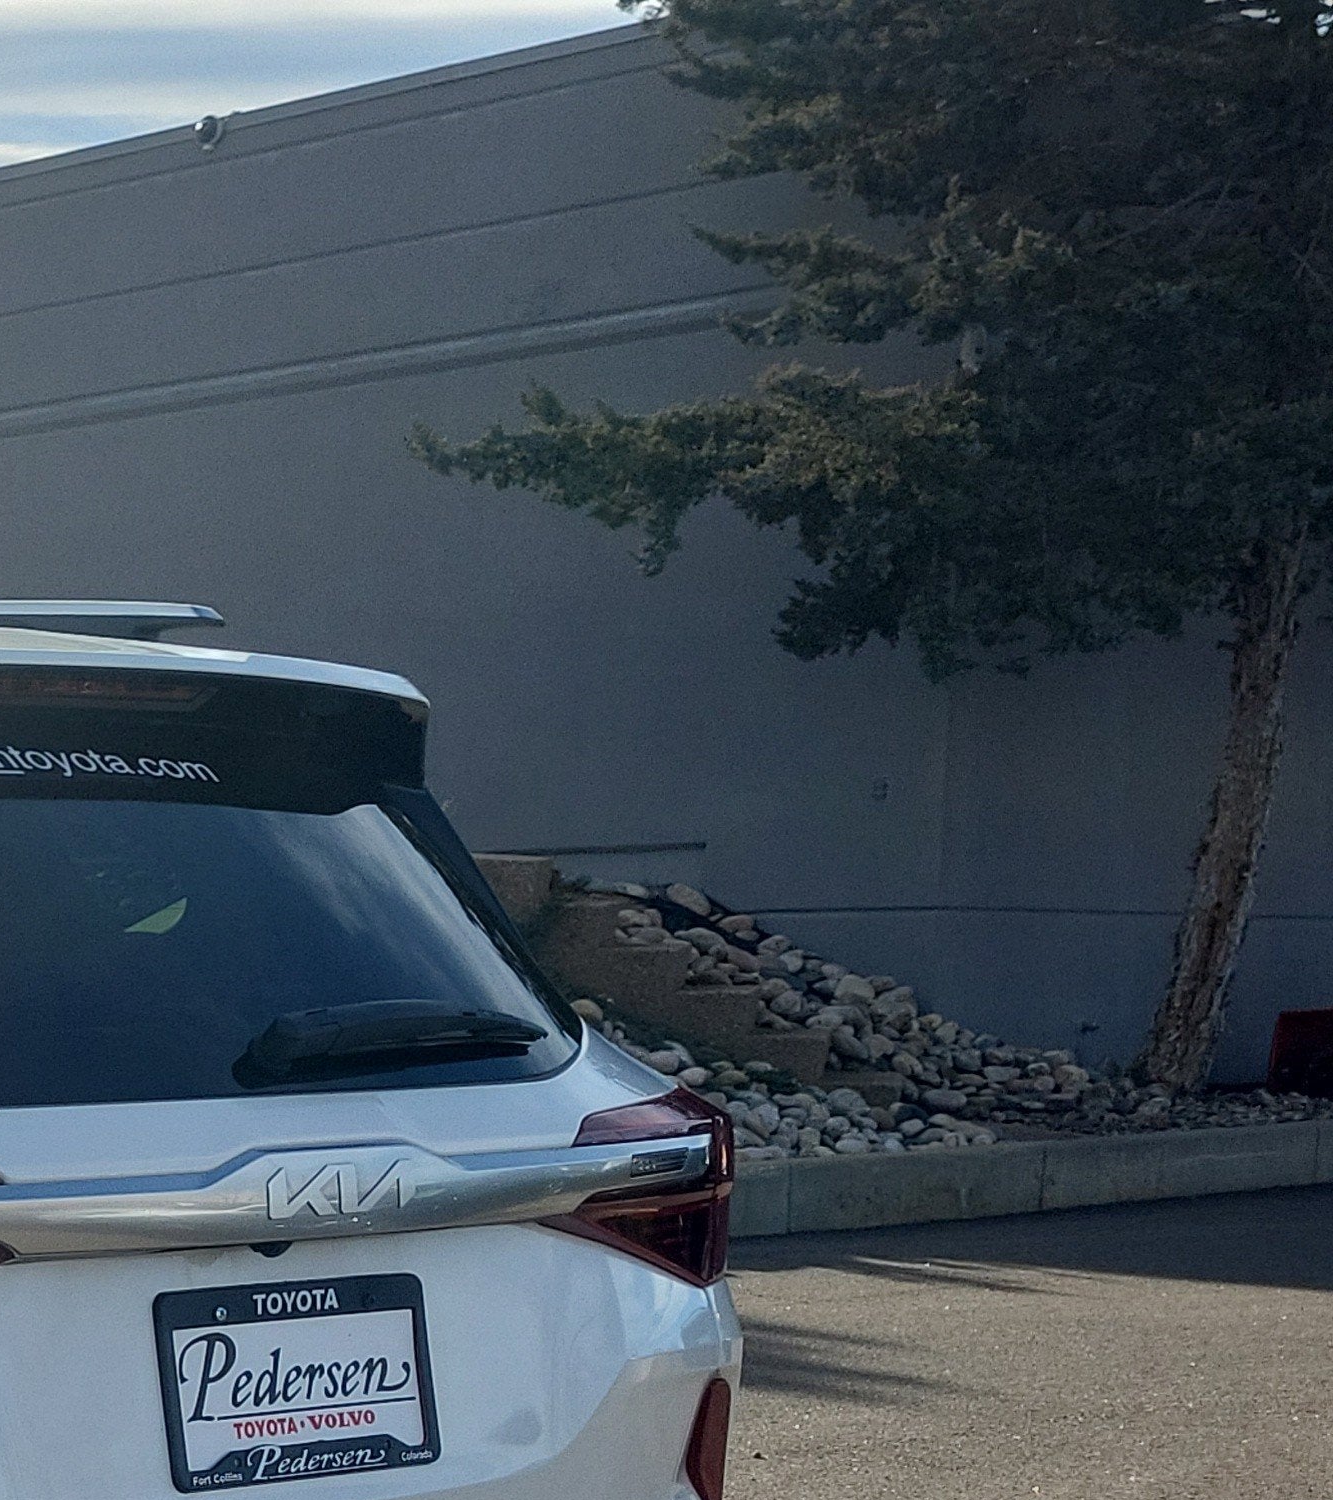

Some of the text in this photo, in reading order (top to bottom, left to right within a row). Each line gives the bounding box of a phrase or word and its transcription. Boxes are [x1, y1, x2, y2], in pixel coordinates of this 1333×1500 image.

[266, 1157, 416, 1220] KIA
[252, 1288, 339, 1315] TOYOTA
[178, 1332, 411, 1423] Pedersen
[233, 1409, 376, 1439] TOYOTA VOLVO
[247, 1445, 385, 1481] Pedersen
